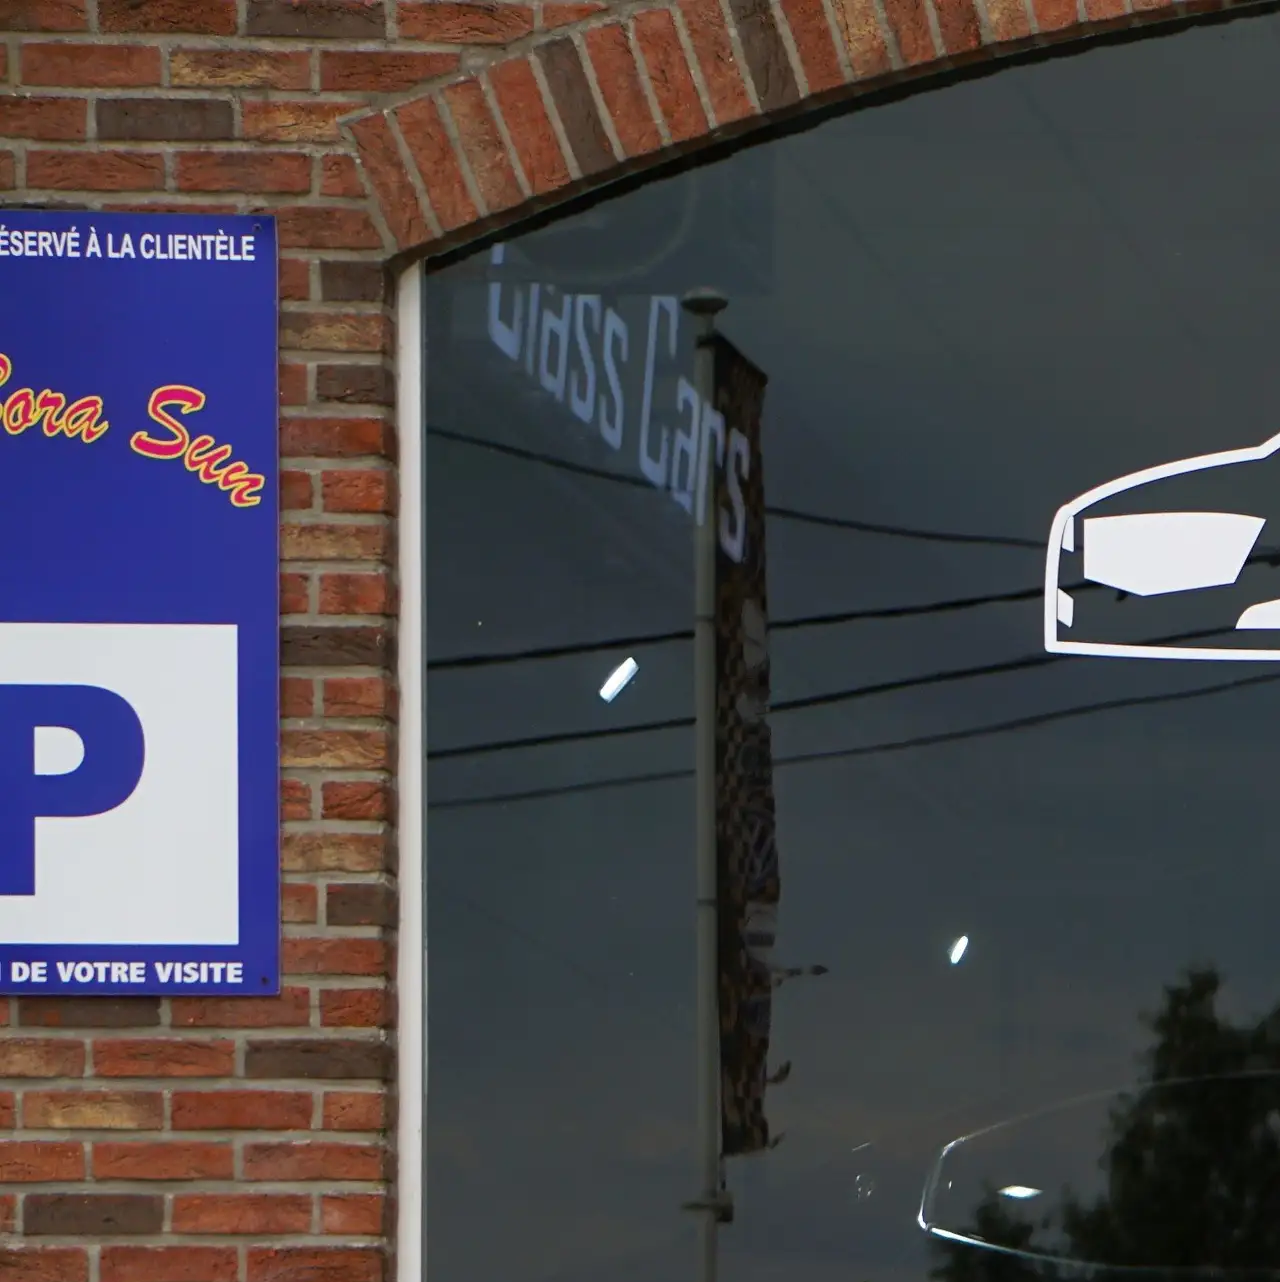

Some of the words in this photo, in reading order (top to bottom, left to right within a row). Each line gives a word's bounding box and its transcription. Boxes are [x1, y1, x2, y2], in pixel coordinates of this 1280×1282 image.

[86, 227, 103, 258] À
[107, 233, 136, 258] LA
[140, 229, 256, 261] CLIENTÈLE
[130, 384, 265, 508] Sun
[639, 295, 750, 564] Cars
[0, 683, 146, 896] P
[11, 961, 48, 983] DE
[56, 961, 146, 984] VOTRE
[154, 961, 244, 984] VISITE
